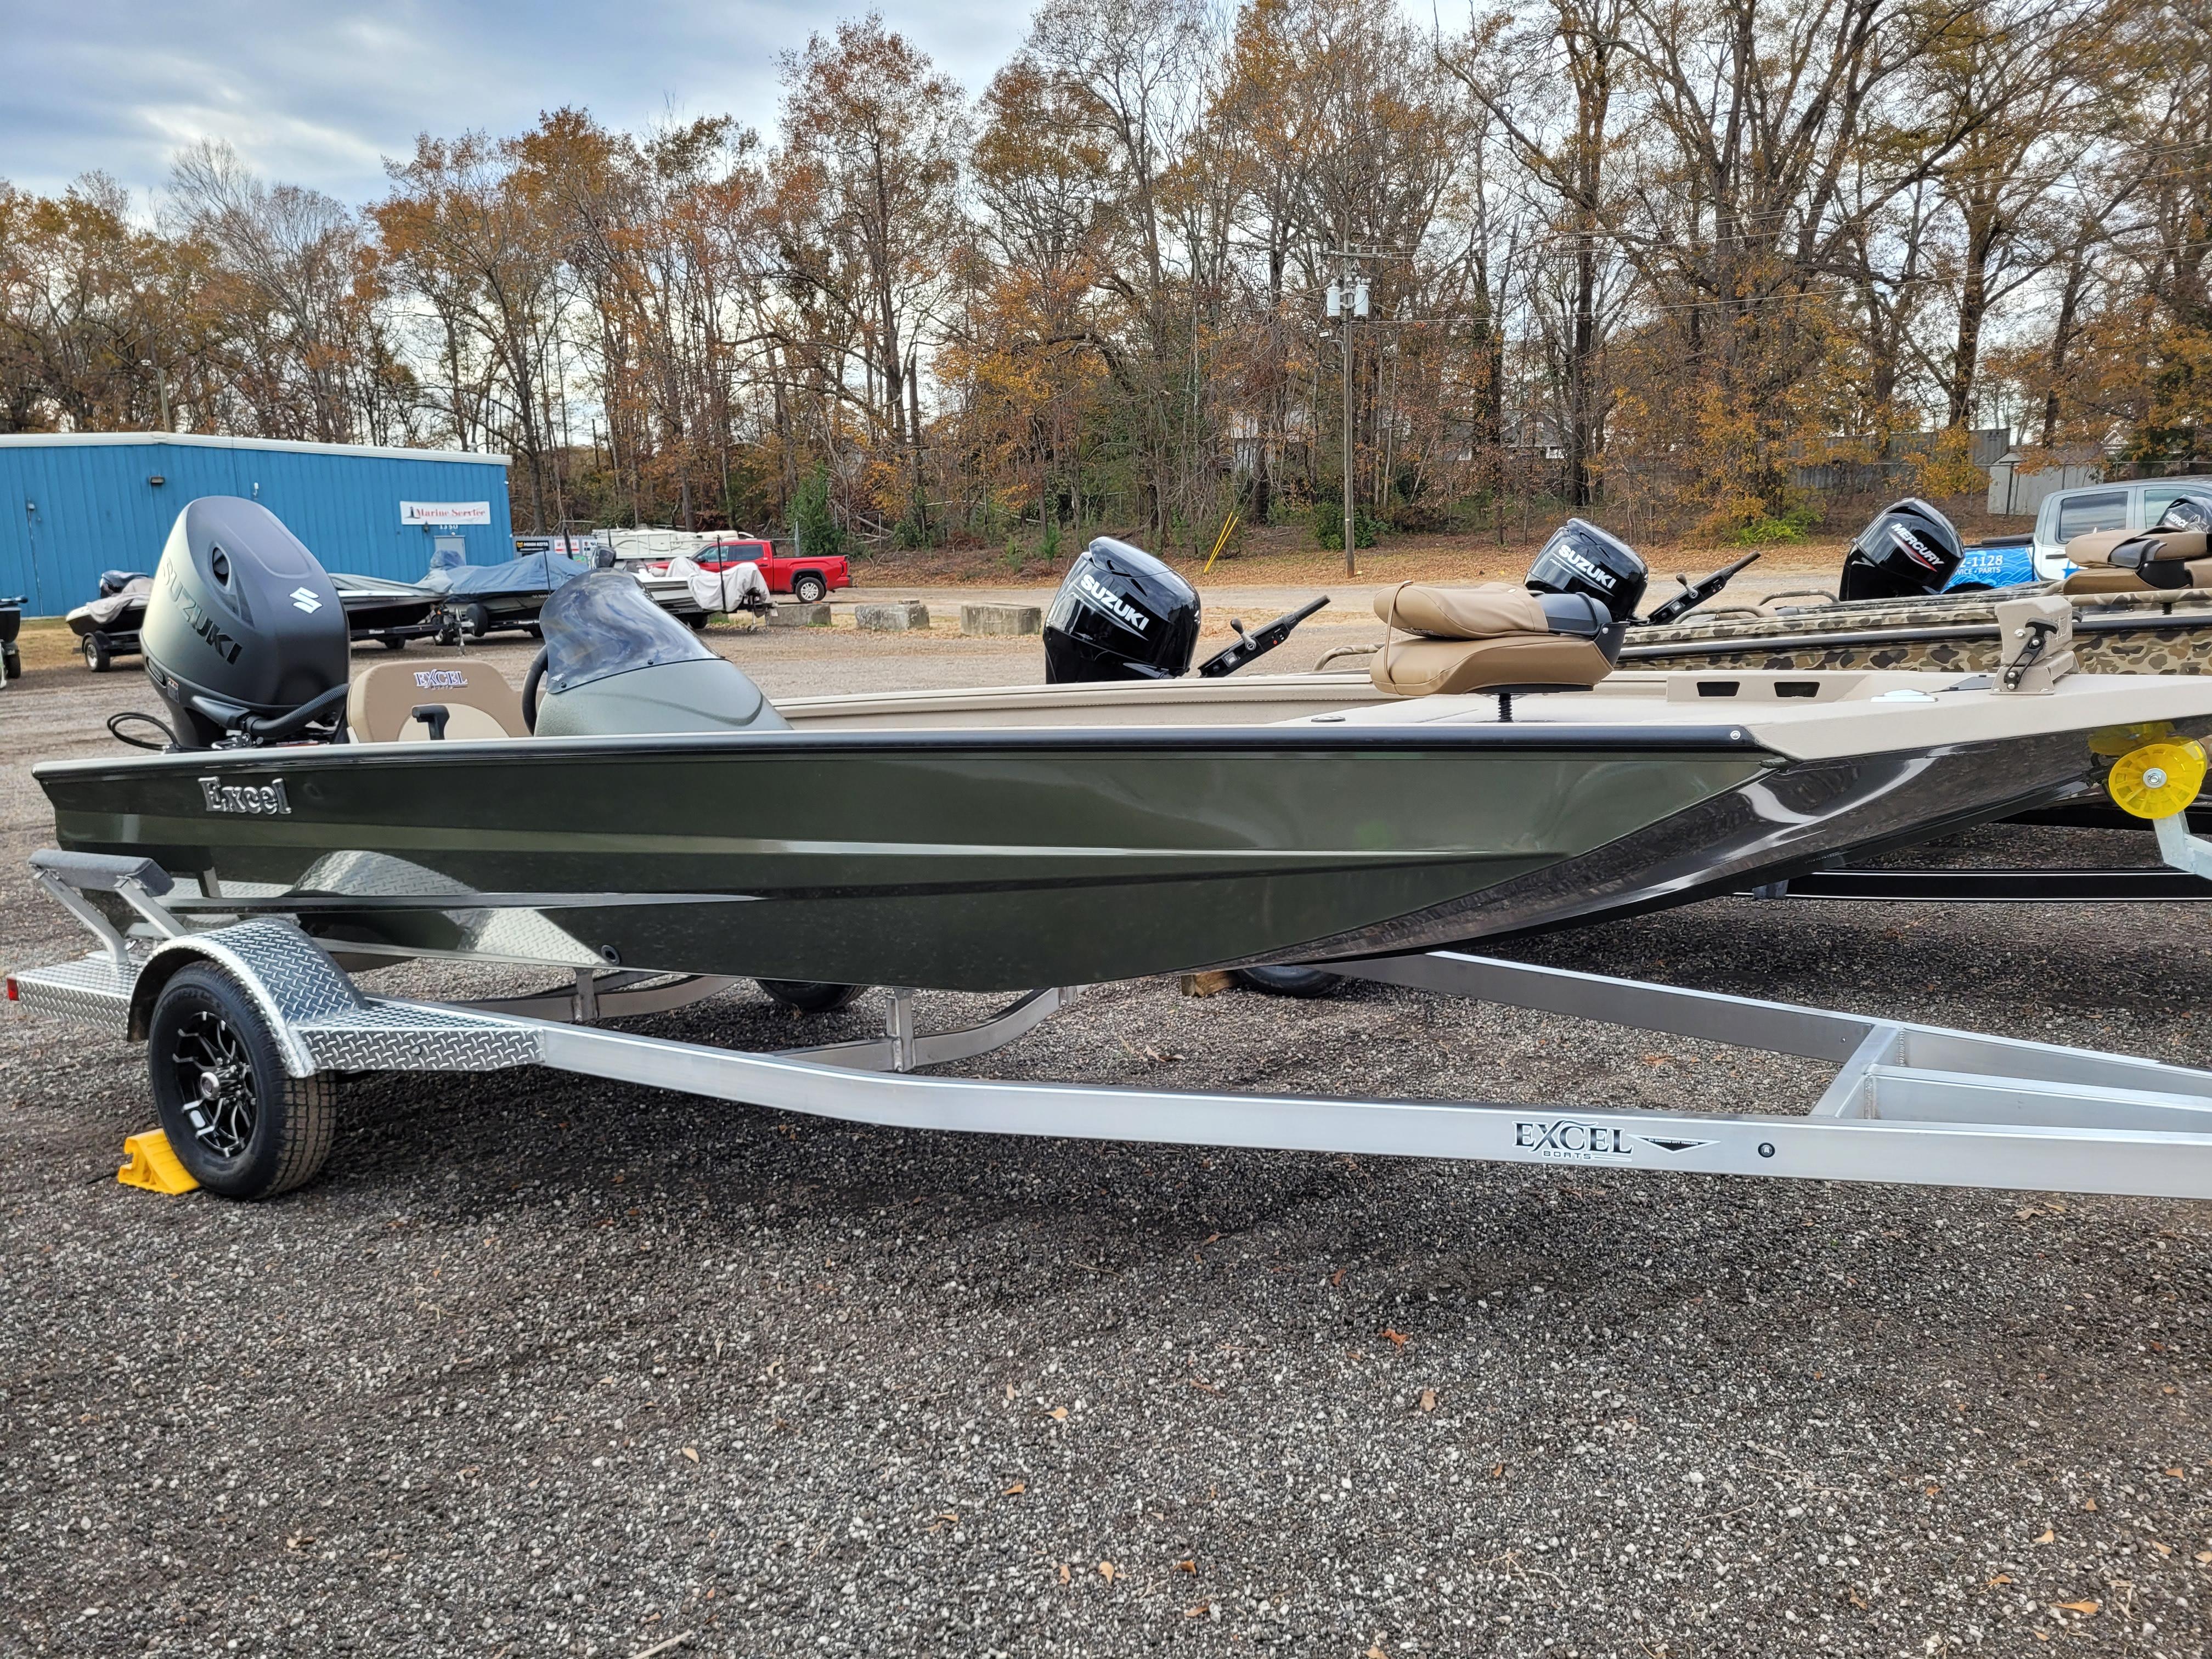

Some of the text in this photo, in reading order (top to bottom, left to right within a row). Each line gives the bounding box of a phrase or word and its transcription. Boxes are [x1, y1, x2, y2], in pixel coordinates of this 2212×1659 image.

[416, 508, 486, 517] Marine Service
[1891, 523, 1945, 566] MERCURY
[1558, 544, 1617, 589] SUZUKI
[163, 557, 243, 665] SUZUKI
[1080, 574, 1150, 631] SUZUKI
[413, 669, 468, 689] EXCEL
[198, 776, 292, 815] Excel
[1512, 1119, 1634, 1155] EXCEL
[1543, 1150, 1592, 1160] BOATS
